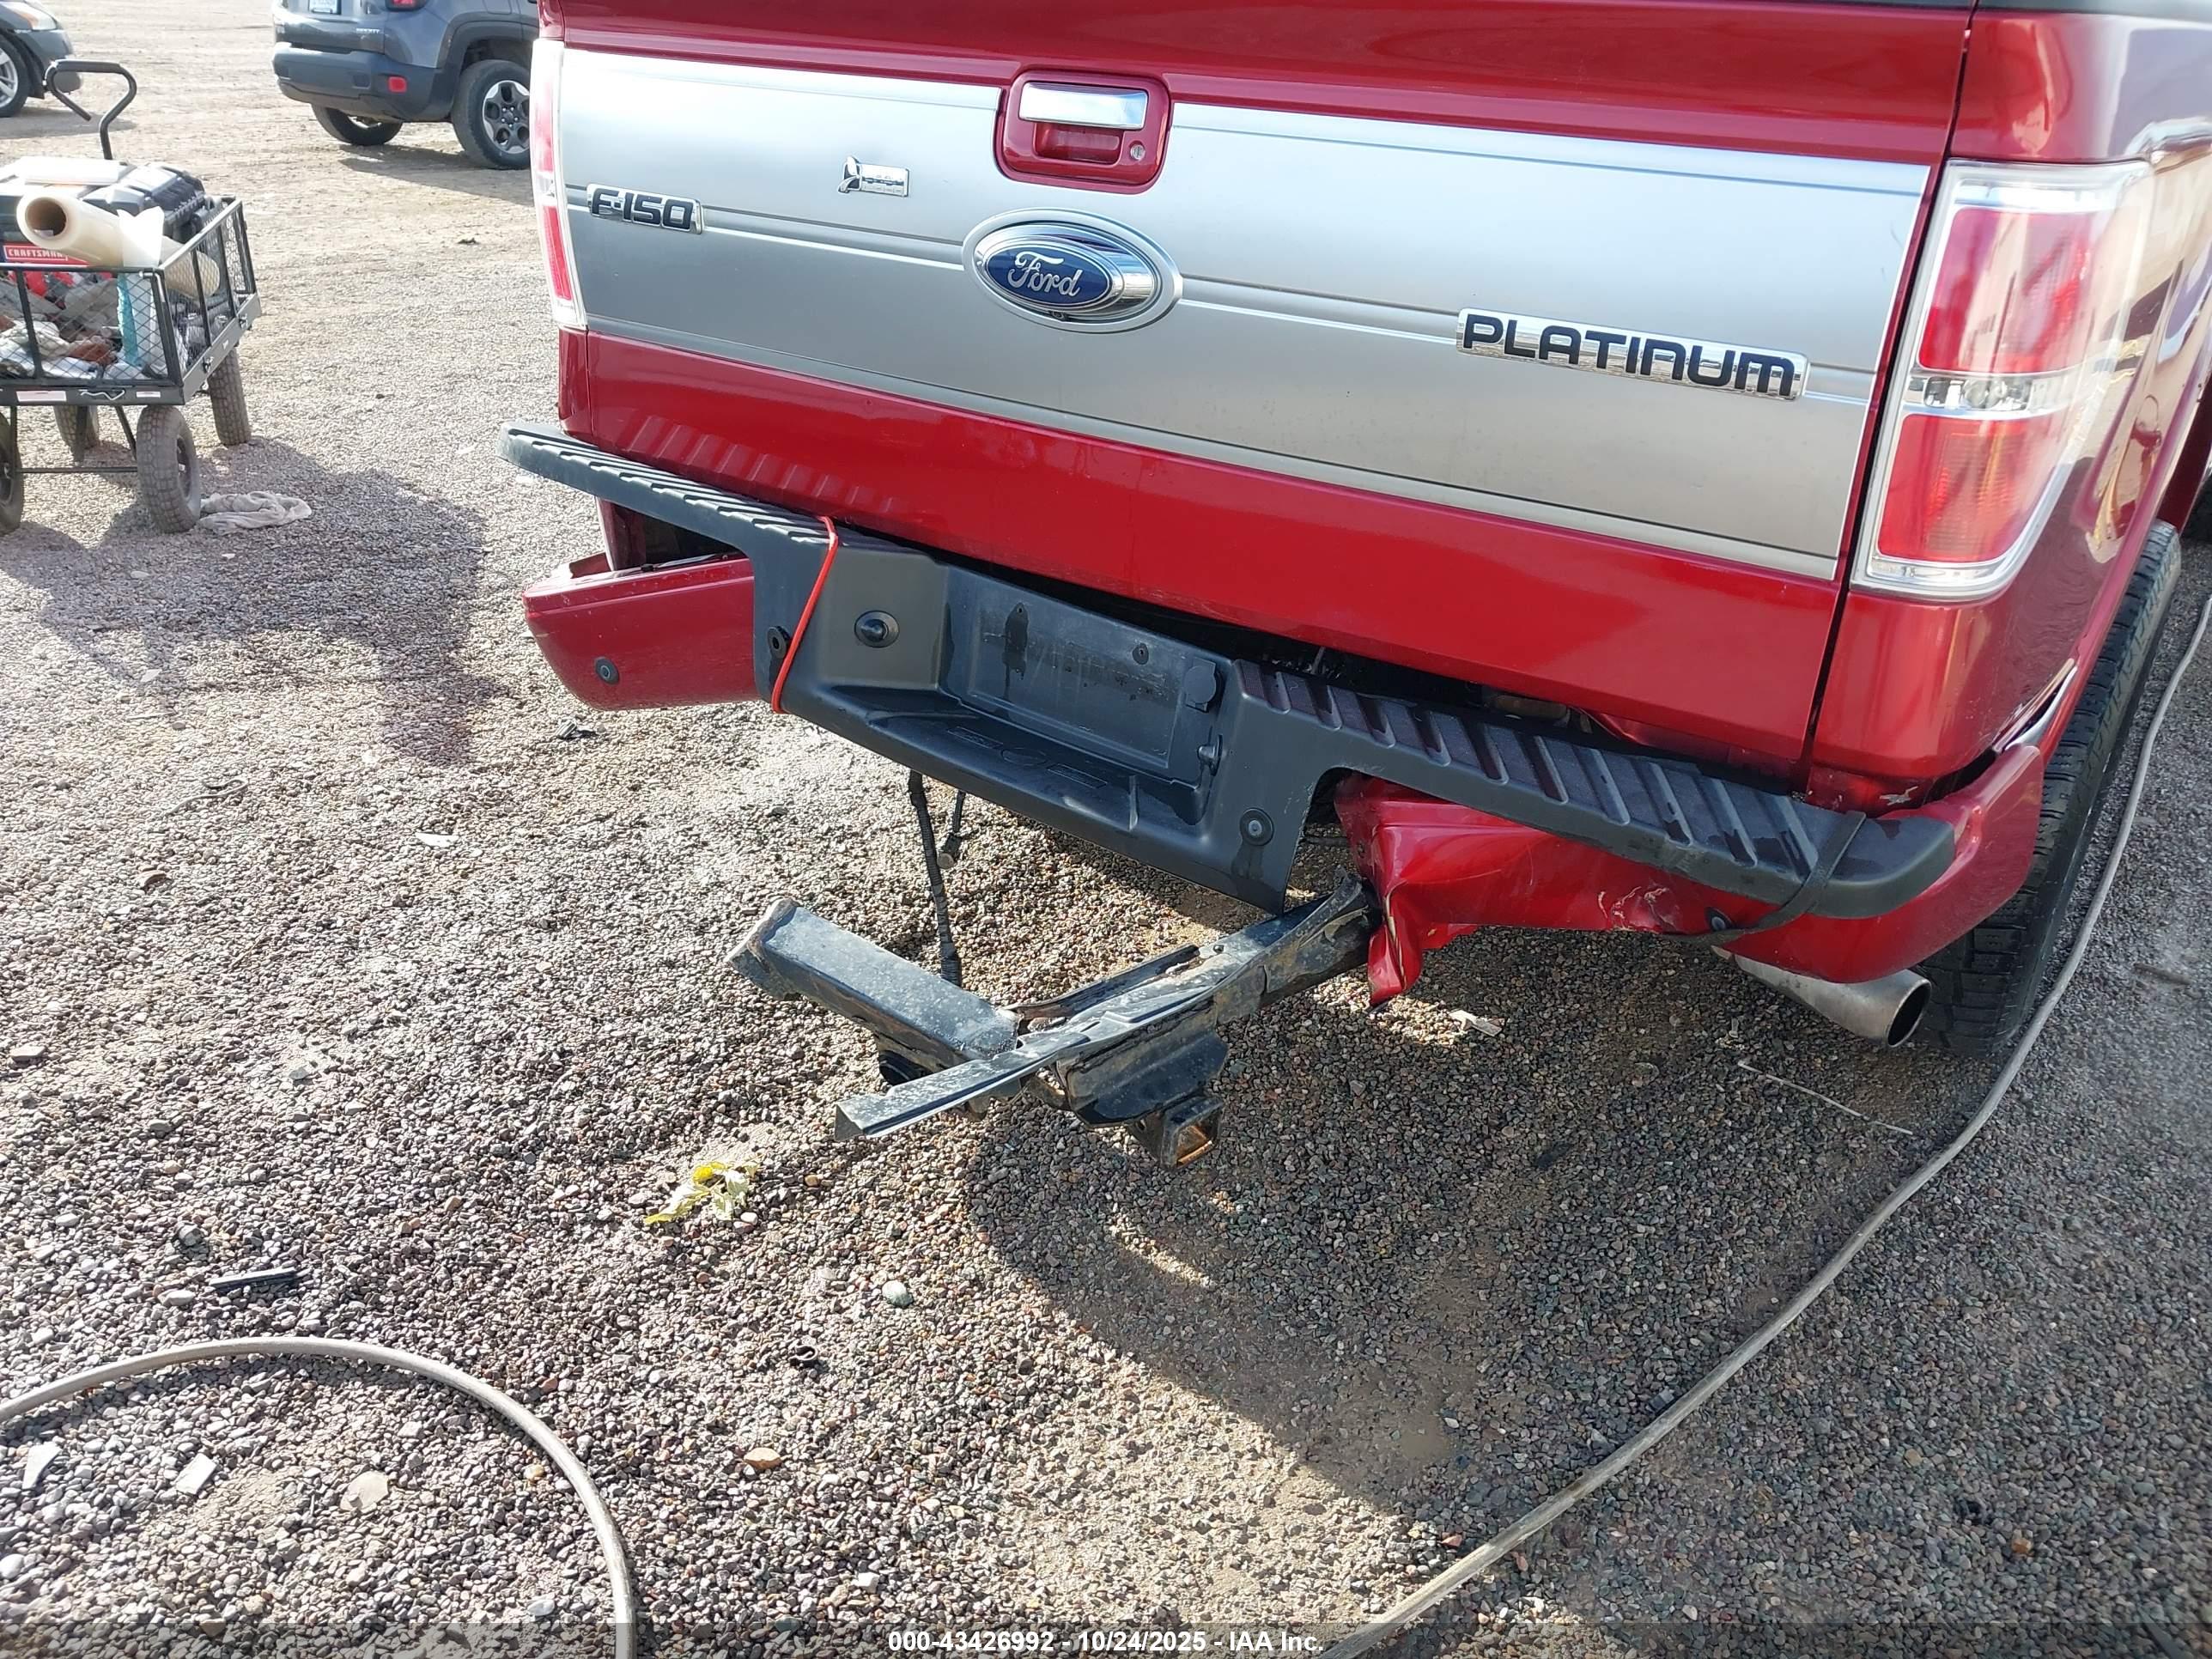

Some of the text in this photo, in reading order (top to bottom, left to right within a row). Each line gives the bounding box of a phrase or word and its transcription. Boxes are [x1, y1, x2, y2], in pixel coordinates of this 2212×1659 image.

[591, 187, 694, 230] F-150
[1006, 250, 1084, 297] Ford
[1462, 313, 1796, 397] PLATINUM
